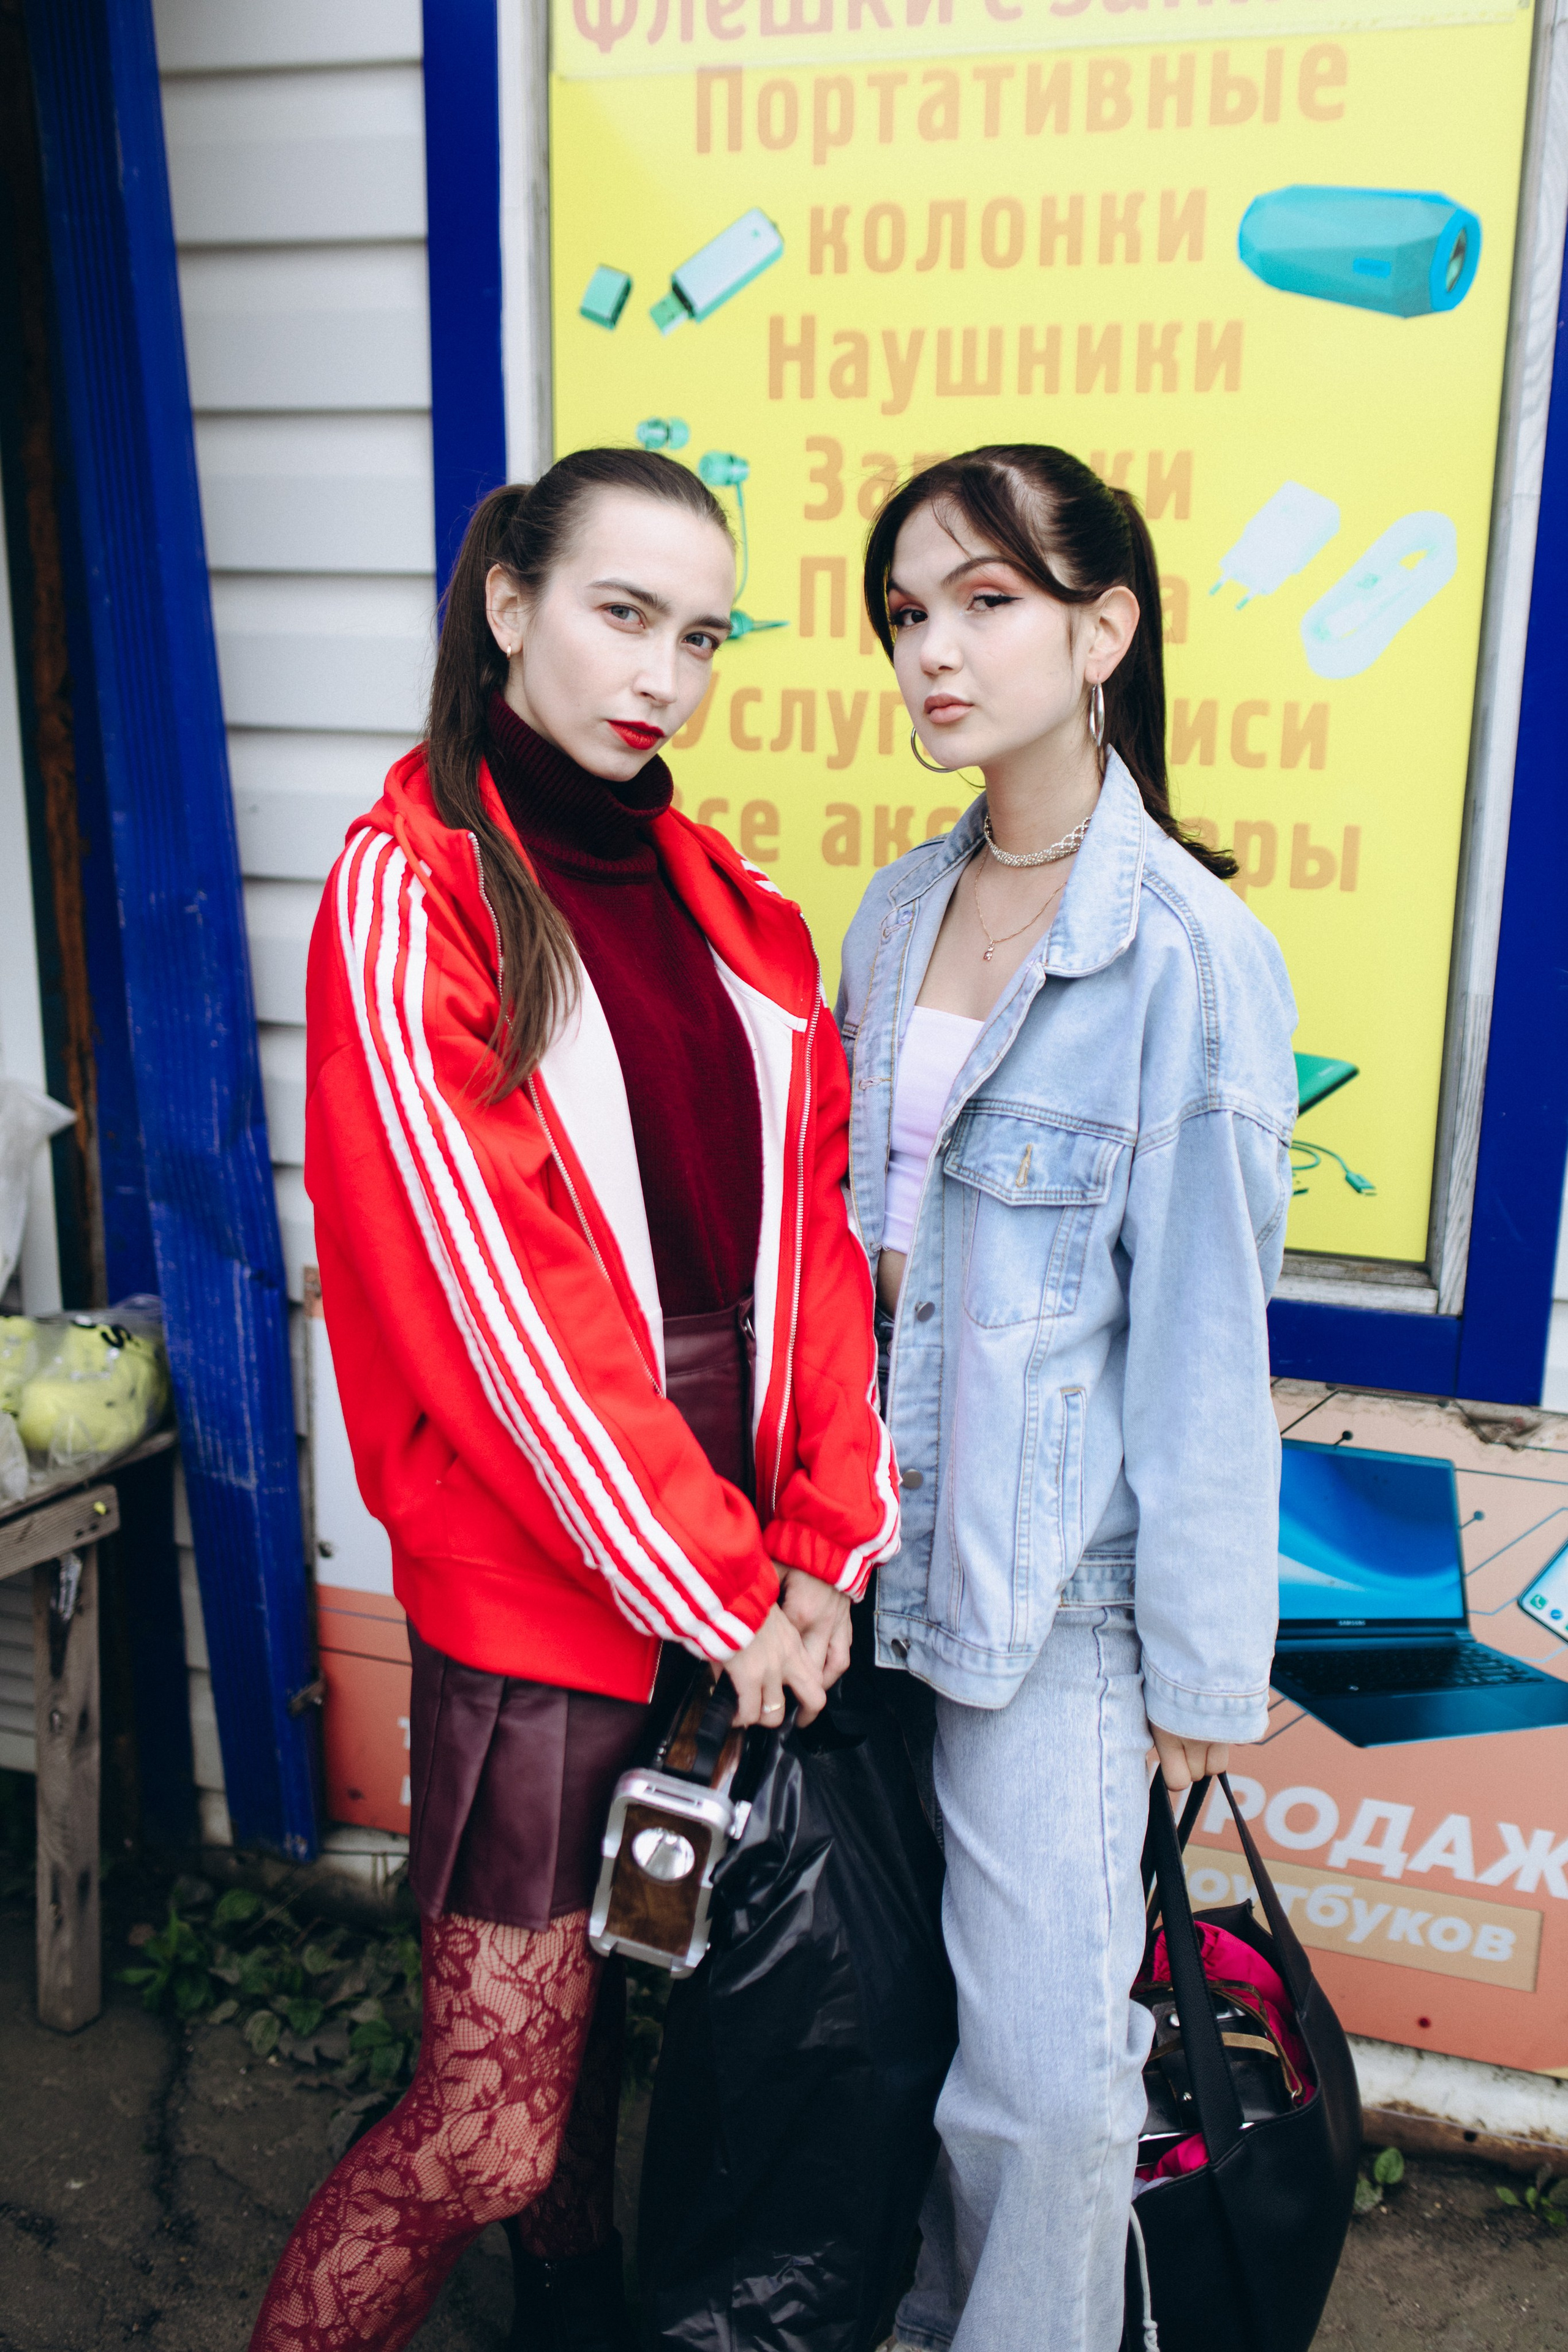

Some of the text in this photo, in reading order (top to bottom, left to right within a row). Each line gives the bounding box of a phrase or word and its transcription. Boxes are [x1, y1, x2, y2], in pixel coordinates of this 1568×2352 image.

[696, 43, 1349, 165] Портативные
[809, 187, 1208, 275] колонки
[768, 314, 1245, 415] Наушники
[1149, 1760, 1568, 1900] РОДАЖ
[1182, 1864, 1517, 1962] отбуков
